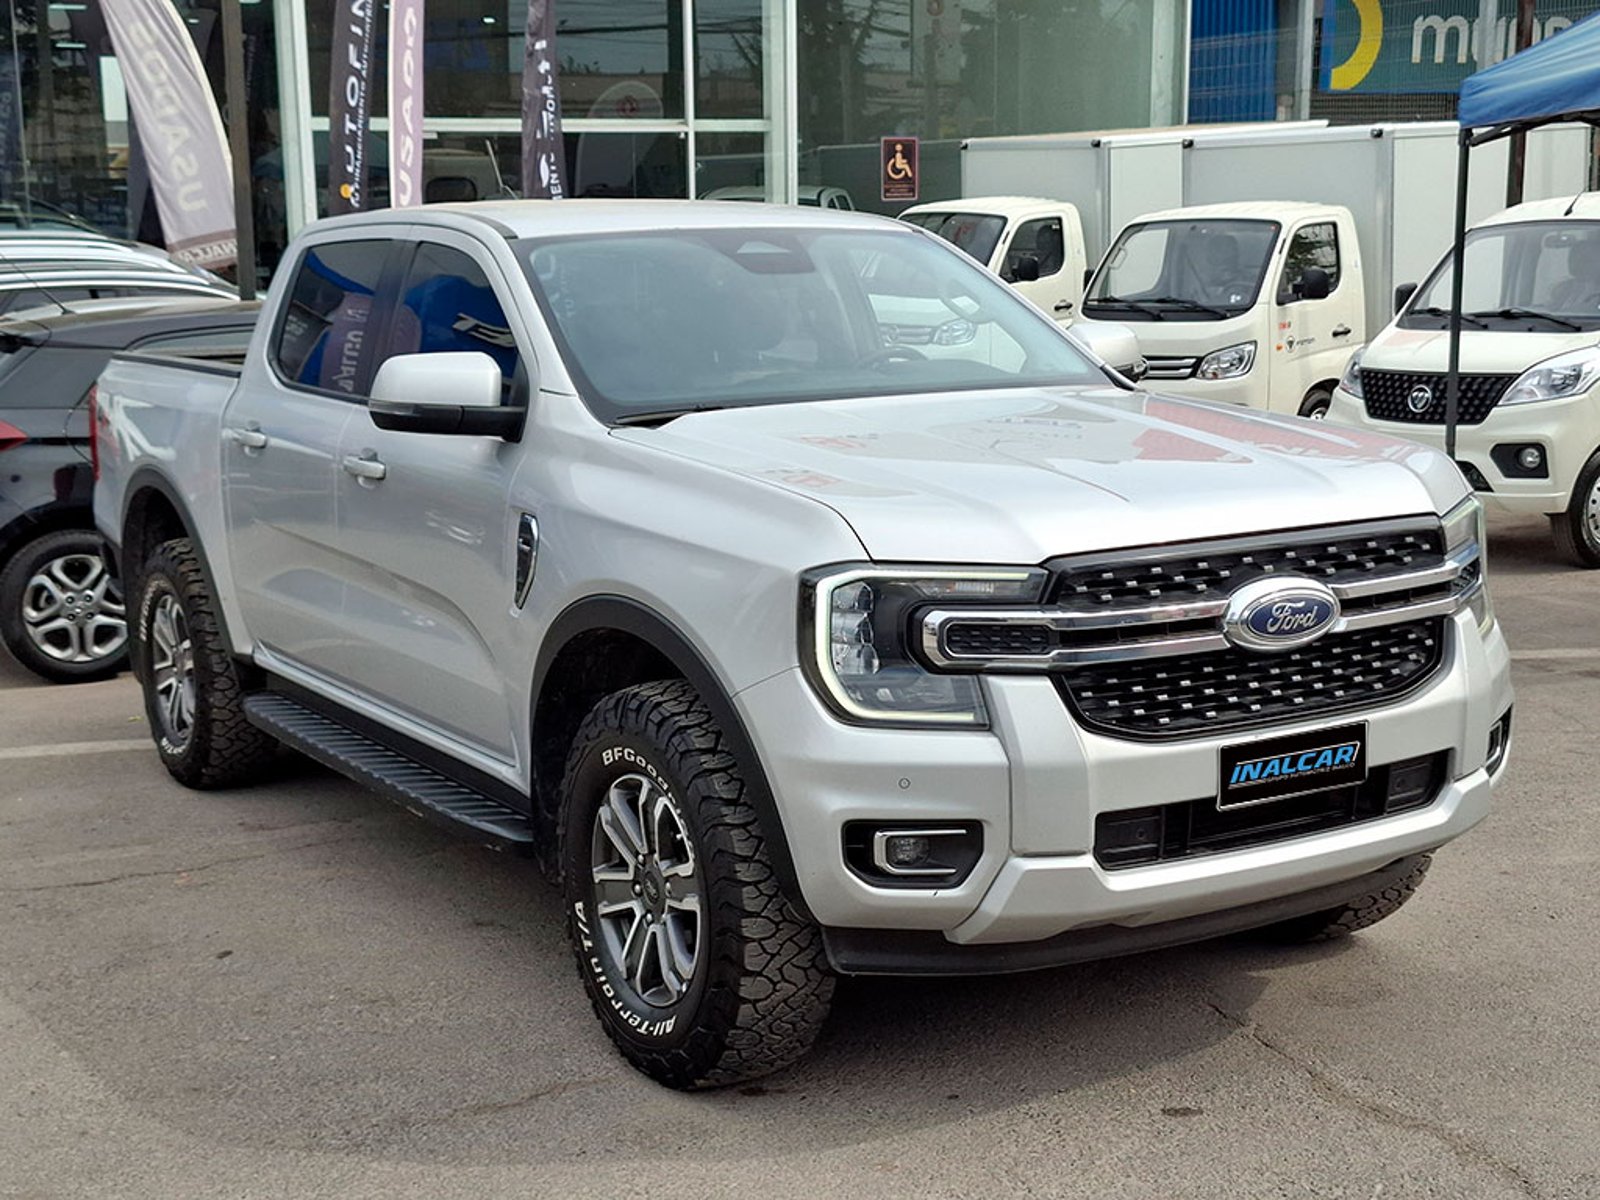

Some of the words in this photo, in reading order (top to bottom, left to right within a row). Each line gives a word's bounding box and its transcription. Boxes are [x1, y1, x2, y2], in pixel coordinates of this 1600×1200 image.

[1266, 601, 1318, 632] Ford
[1229, 745, 1355, 783] INALCAR
[591, 957, 677, 1036] All-Terrain
